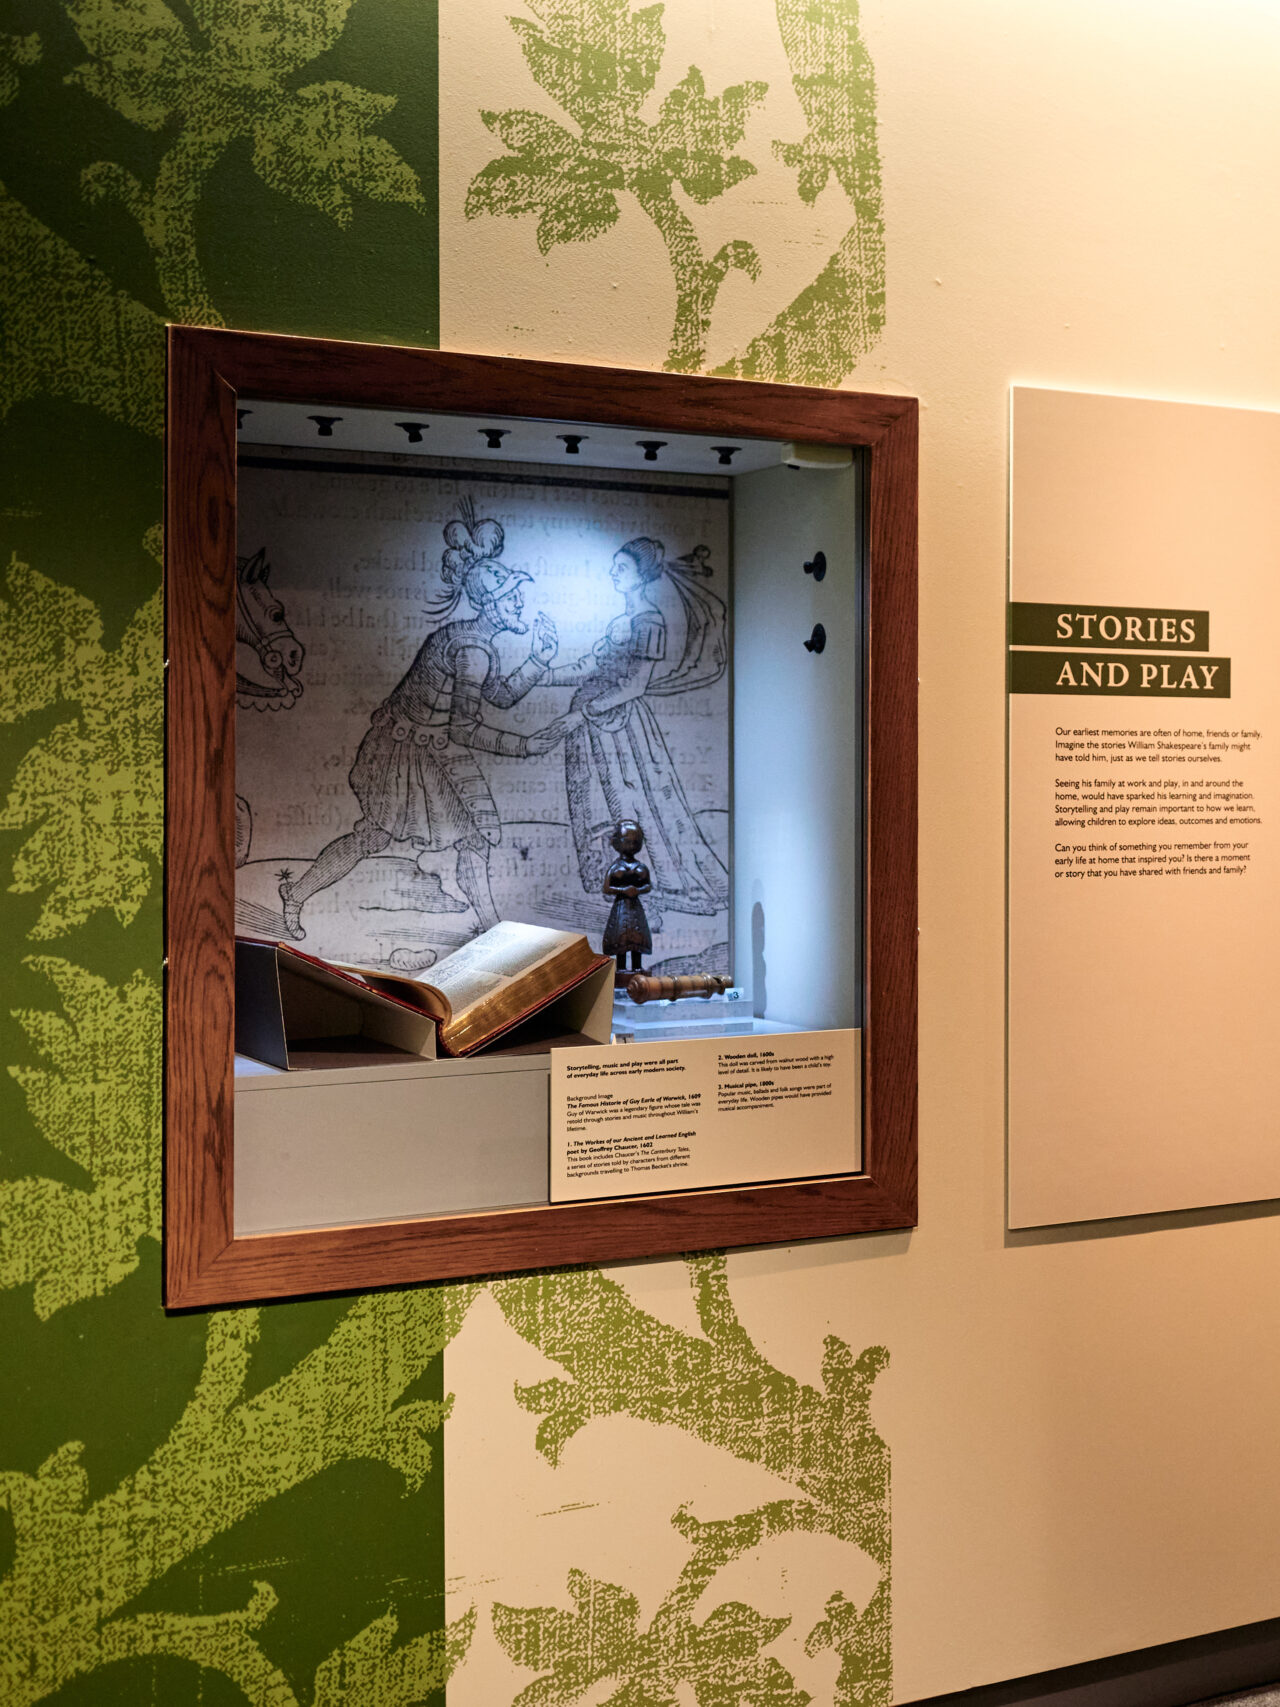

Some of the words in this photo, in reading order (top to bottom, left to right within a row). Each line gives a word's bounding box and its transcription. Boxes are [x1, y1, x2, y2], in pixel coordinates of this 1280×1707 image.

[1056, 613, 1196, 644] STORIES
[1056, 661, 1130, 687] AND
[1140, 664, 1219, 690] PLAY
[1055, 726, 1071, 736] Our
[1072, 727, 1099, 736] earliest
[1152, 728, 1171, 736] often
[1182, 729, 1204, 737] home,
[1206, 729, 1229, 737] friends
[1241, 729, 1262, 740] family.
[1055, 739, 1084, 751] Imagine
[1086, 740, 1099, 749] the
[1127, 741, 1155, 749] William
[1157, 740, 1206, 751] Shakespeare's
[1208, 742, 1228, 751] family
[1231, 742, 1250, 752] might
[1055, 752, 1073, 761] have
[1074, 753, 1090, 761] told
[1092, 753, 1108, 762] him,
[1110, 754, 1123, 763] just
[1054, 778, 1080, 789] Seeing
[1081, 778, 1092, 787] his
[1093, 778, 1116, 789] family
[1163, 779, 1180, 789] play,
[1054, 791, 1079, 801] home,
[1081, 791, 1104, 800] would
[1106, 792, 1124, 800] have
[1126, 791, 1155, 801] sparked
[1168, 792, 1197, 801] learning
[1054, 804, 1097, 815] Storytelling
[1099, 804, 1112, 812] and
[1114, 804, 1130, 814] play
[1159, 805, 1194, 814] important
[1054, 817, 1085, 828] allowing
[1086, 817, 1116, 825] children
[1128, 817, 1155, 827] explore
[1054, 842, 1070, 852] Can
[1072, 845, 1086, 854] you
[1088, 843, 1107, 851] think
[1109, 842, 1117, 851] of
[1118, 842, 1157, 852] something
[1158, 844, 1172, 852] you
[1174, 841, 1211, 849] remember
[1232, 842, 1248, 850] your
[1054, 856, 1073, 867] early
[1075, 855, 1086, 864] life
[1097, 855, 1119, 864] home
[1121, 855, 1136, 863] that
[1137, 854, 1166, 865] inspired
[1168, 854, 1184, 864] you?
[1065, 870, 1085, 879] story
[1086, 868, 1102, 877] that
[1103, 870, 1117, 879] you
[1119, 868, 1137, 876] have
[1138, 867, 1163, 876] shared
[1164, 866, 1181, 874] with
[1182, 866, 1206, 874] friends
[1208, 866, 1221, 874] and
[1223, 865, 1246, 875] family?
